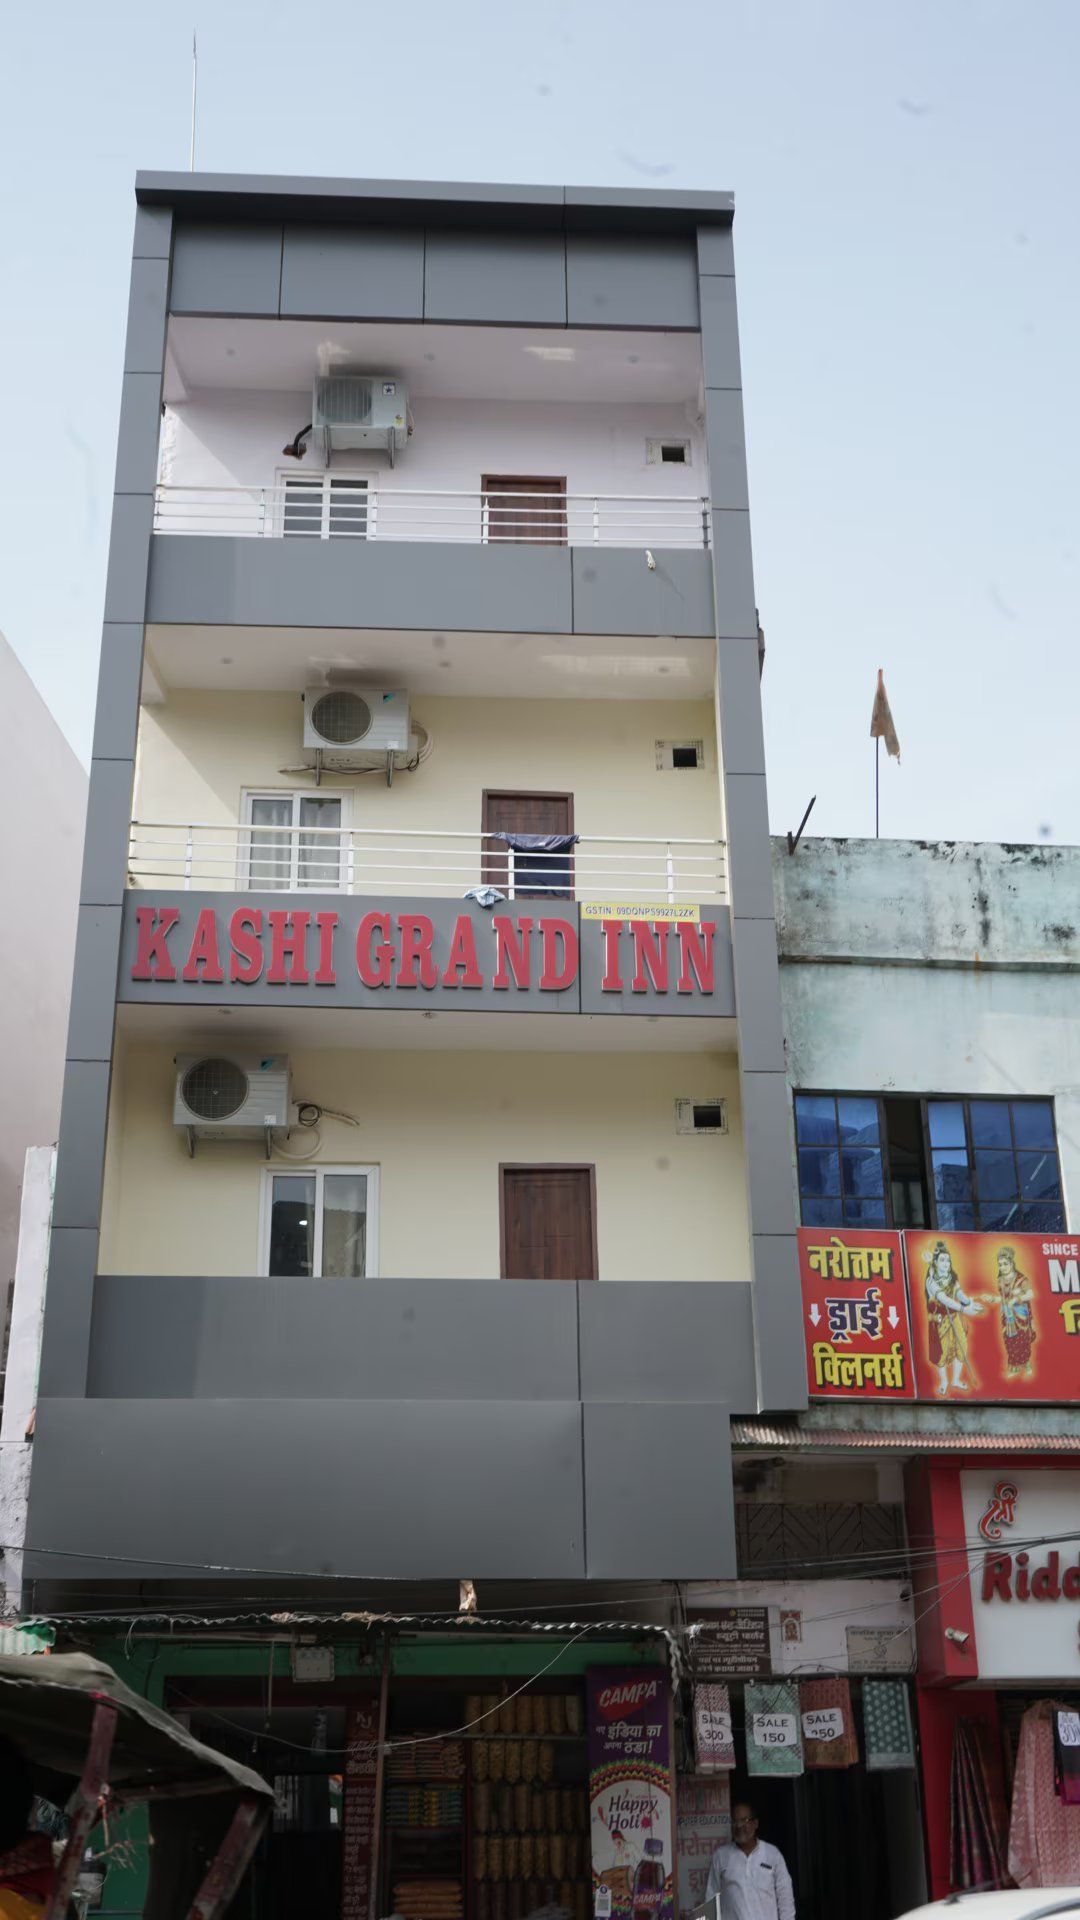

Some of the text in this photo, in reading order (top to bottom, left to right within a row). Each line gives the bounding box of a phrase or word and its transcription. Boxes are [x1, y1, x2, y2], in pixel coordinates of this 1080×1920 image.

[131, 907, 717, 995] KASHI GRAND INN
[1042, 1243, 1079, 1256] SINCE
[825, 1287, 882, 1343] ड्राई
[979, 1480, 1018, 1543] श्री
[599, 1680, 658, 1707] CAMPA
[702, 1714, 726, 1725] SALE
[757, 1718, 789, 1728] SALE
[806, 1713, 837, 1724] SALE
[607, 1721, 643, 1740] इंडिया
[646, 1724, 663, 1737] का
[705, 1730, 724, 1741] 300
[762, 1732, 786, 1743] 150
[624, 1738, 654, 1754] ठंडा!
[608, 1796, 658, 1814] Happy
[608, 1814, 640, 1831] Holi
